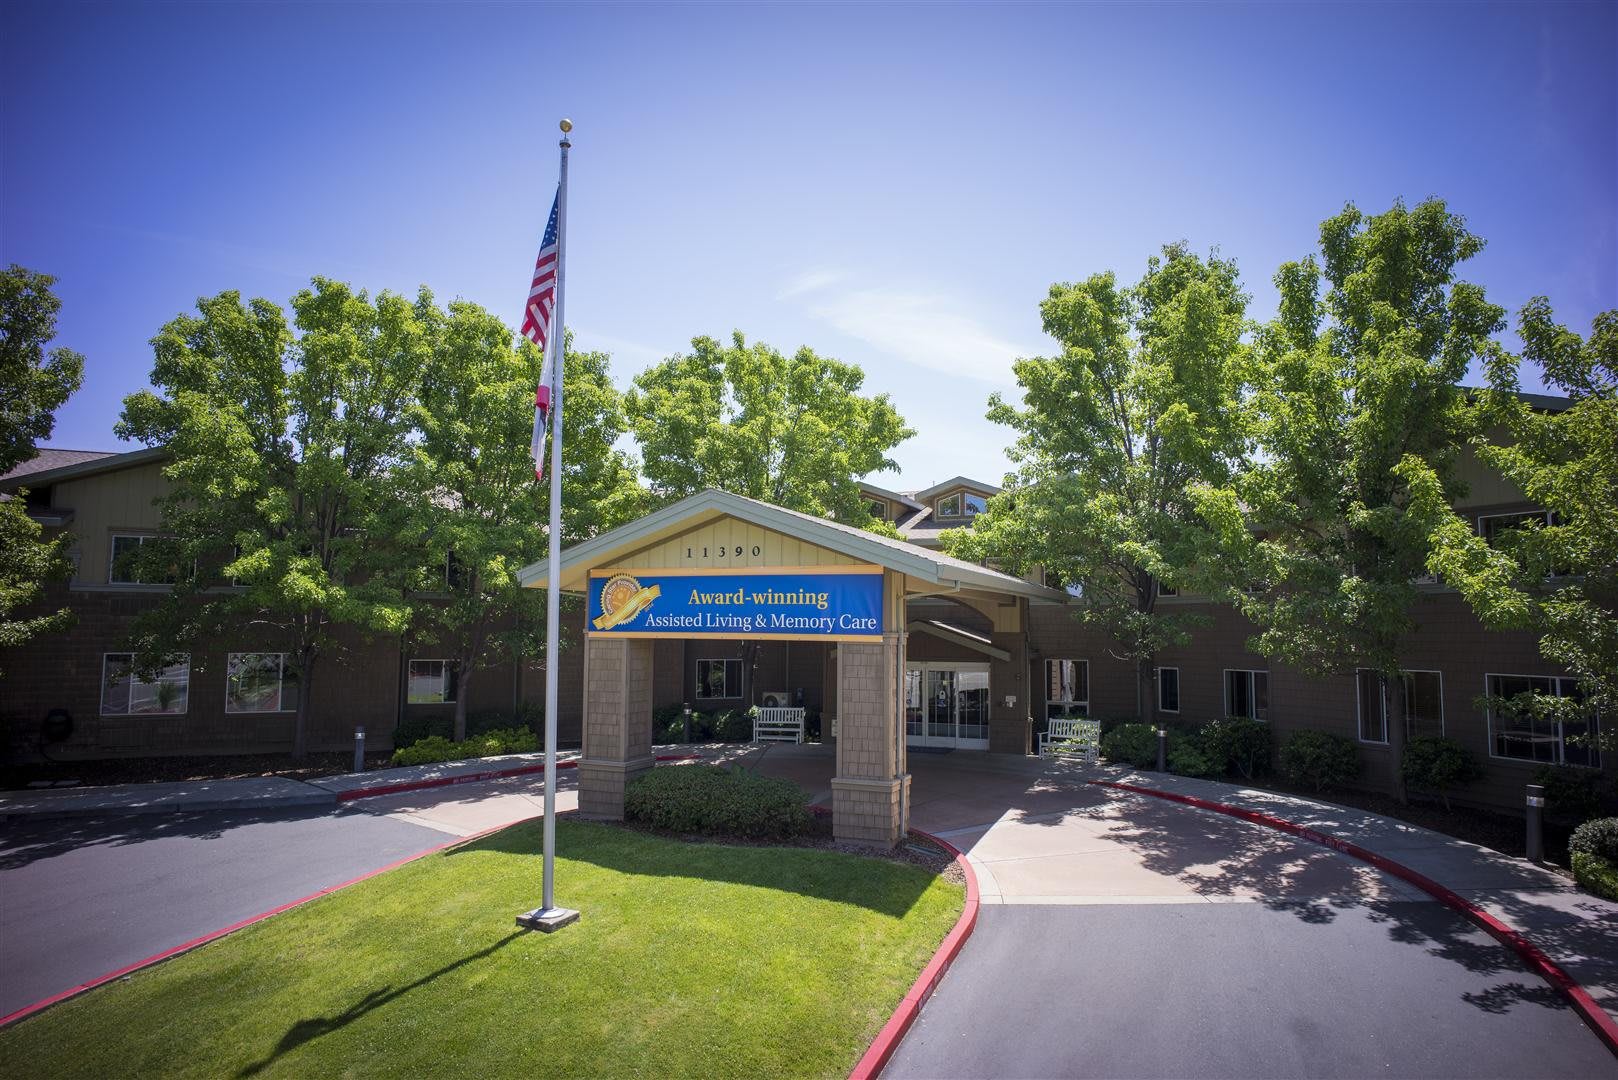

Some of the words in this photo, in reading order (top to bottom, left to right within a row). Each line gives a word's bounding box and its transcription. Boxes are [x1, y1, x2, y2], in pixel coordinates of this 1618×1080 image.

[687, 545, 761, 558] 11390
[688, 588, 829, 610] Award-winning
[645, 613, 702, 627] Assisted
[706, 613, 752, 631] Living
[755, 613, 767, 628] &
[770, 613, 835, 632] Memory
[840, 614, 877, 630] Care
